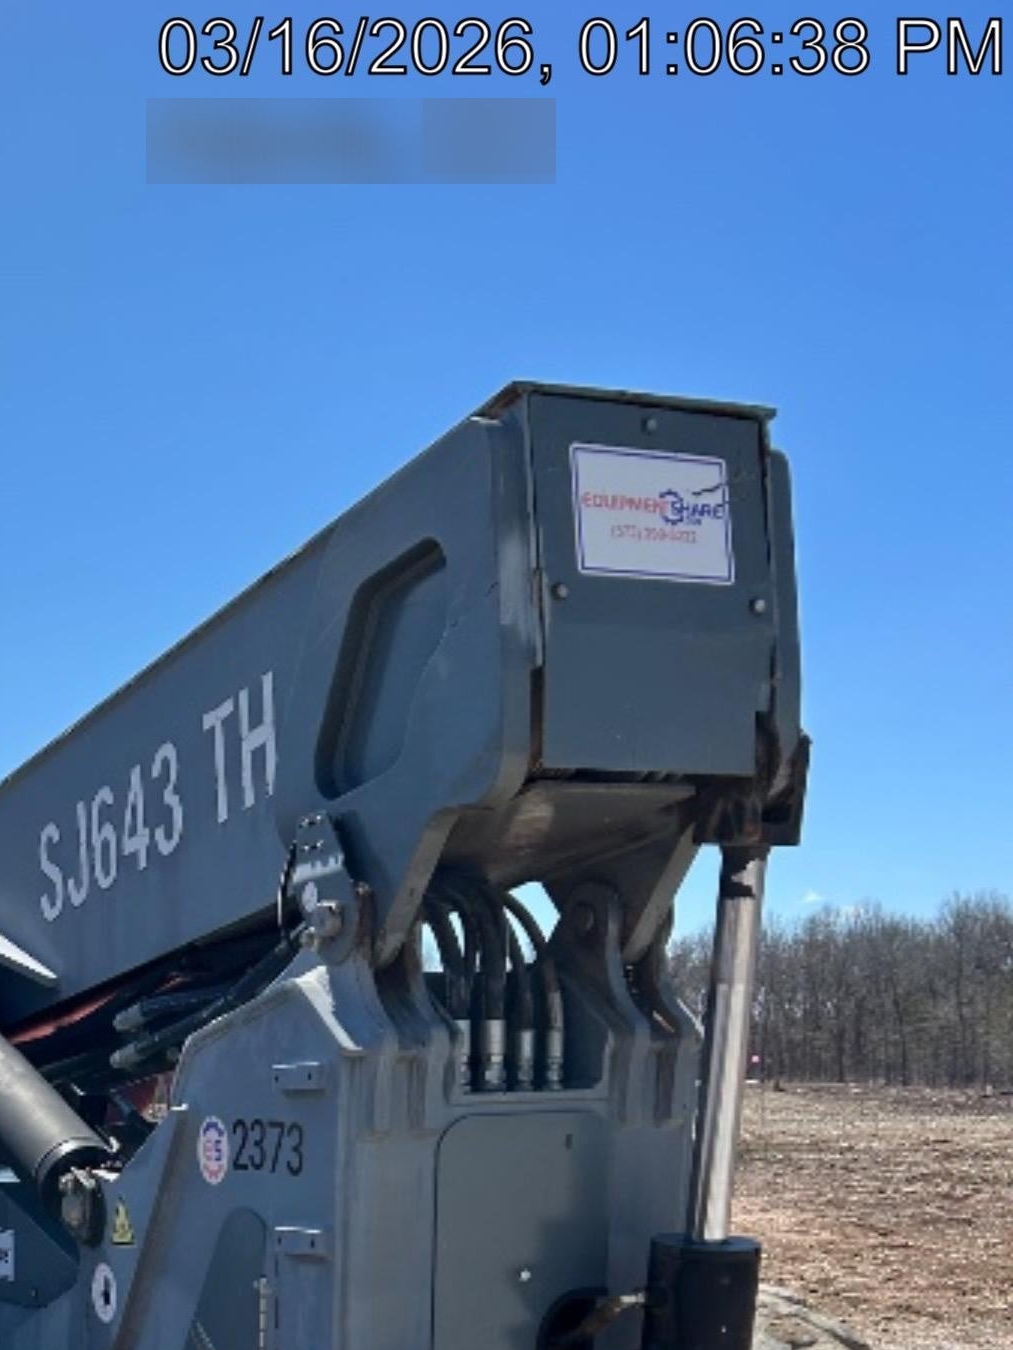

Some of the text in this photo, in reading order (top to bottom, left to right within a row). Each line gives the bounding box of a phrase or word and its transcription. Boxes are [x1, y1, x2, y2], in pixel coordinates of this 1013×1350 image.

[39, 670, 276, 922] SJ643 TH
[232, 1118, 303, 1176] 2373
